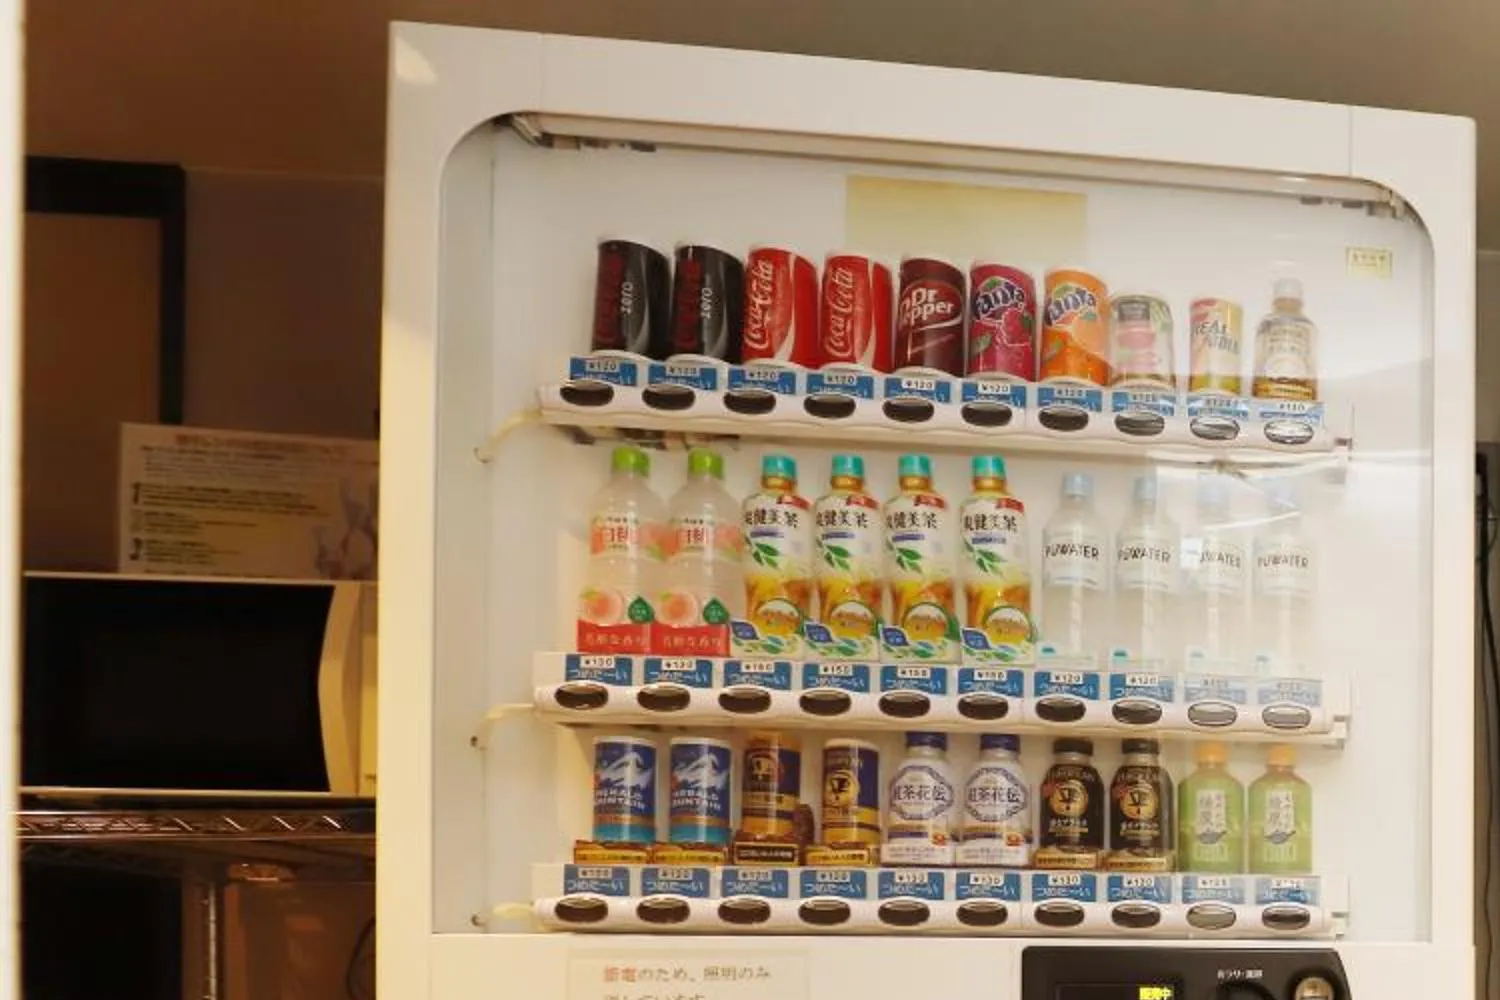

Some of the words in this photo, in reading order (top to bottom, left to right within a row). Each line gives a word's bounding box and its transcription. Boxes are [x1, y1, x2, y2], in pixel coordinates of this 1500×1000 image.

[620, 282, 633, 315] zero
[700, 287, 713, 319] zero
[911, 287, 938, 306] Dr
